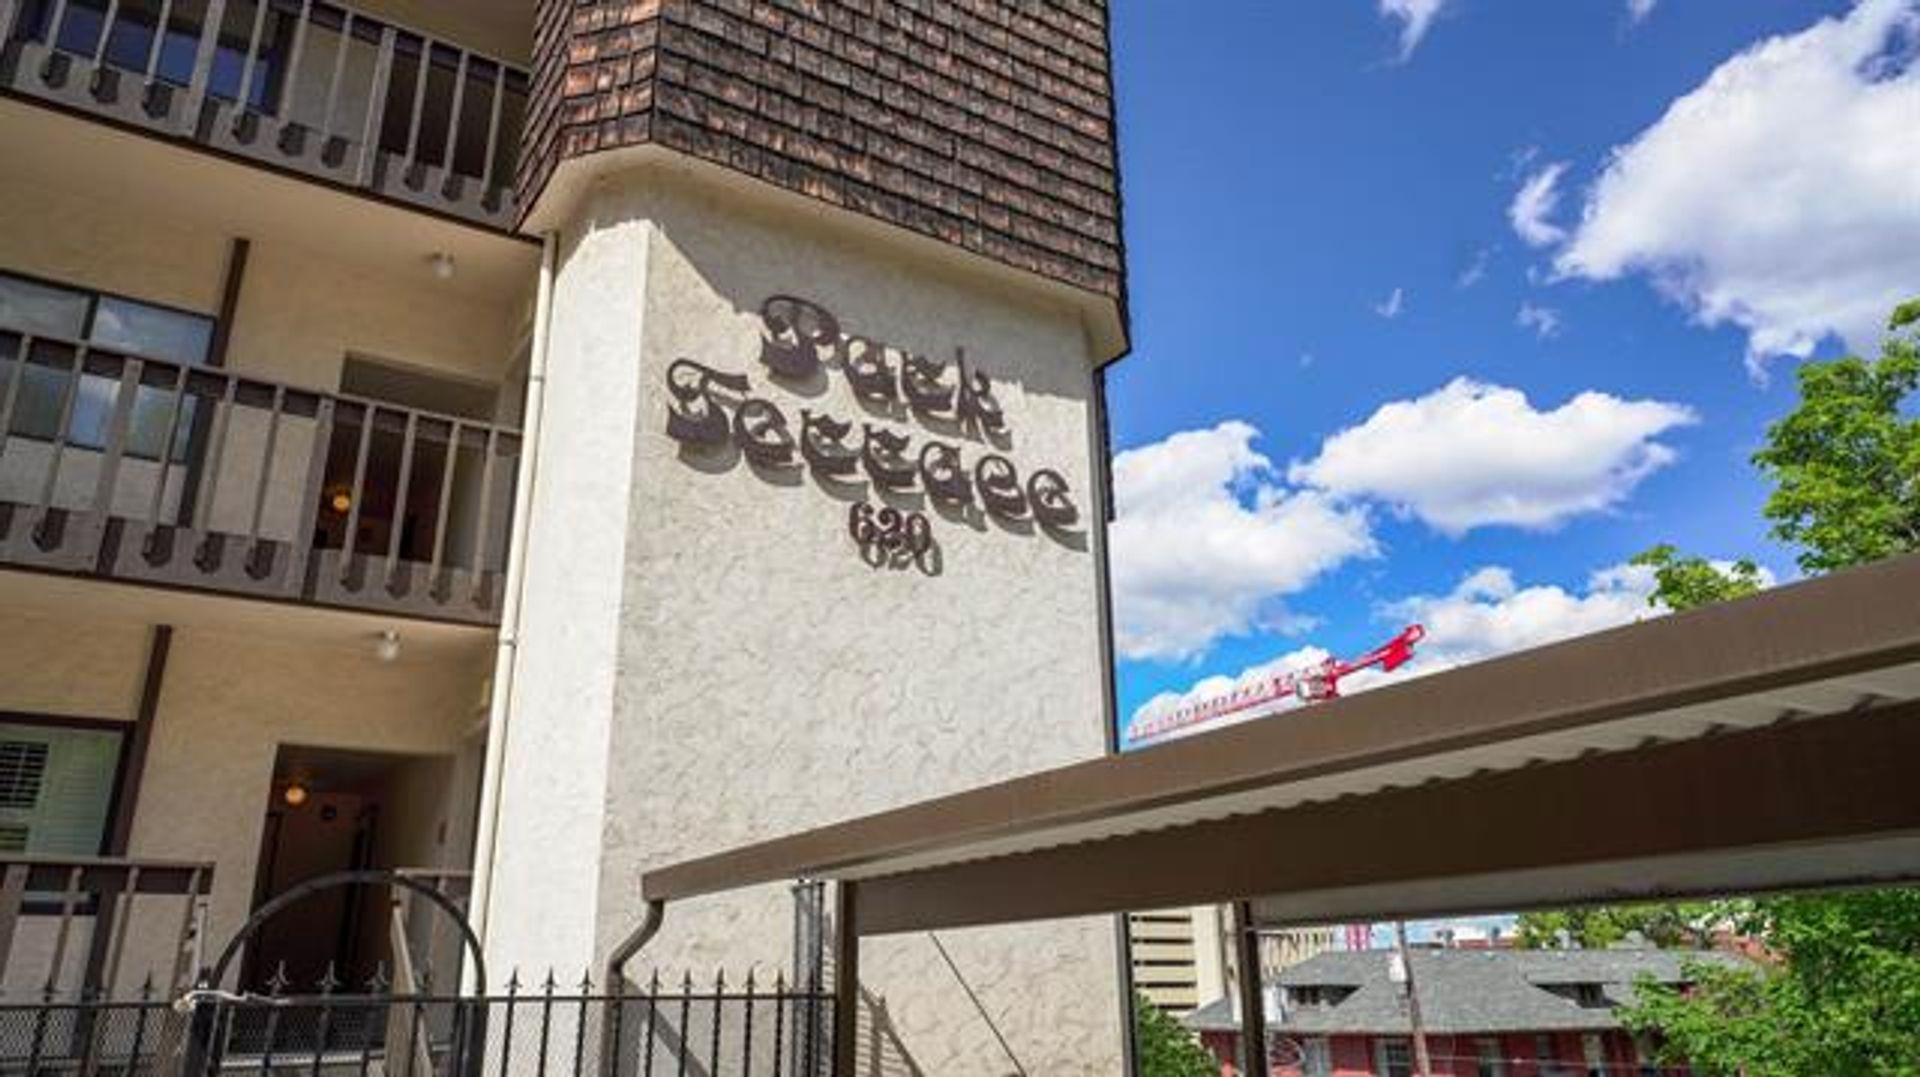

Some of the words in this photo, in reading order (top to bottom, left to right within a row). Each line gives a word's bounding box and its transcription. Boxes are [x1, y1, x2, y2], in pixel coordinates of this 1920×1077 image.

[760, 294, 1004, 427] Park
[667, 358, 1079, 526] Terrace
[849, 501, 932, 553] 620
